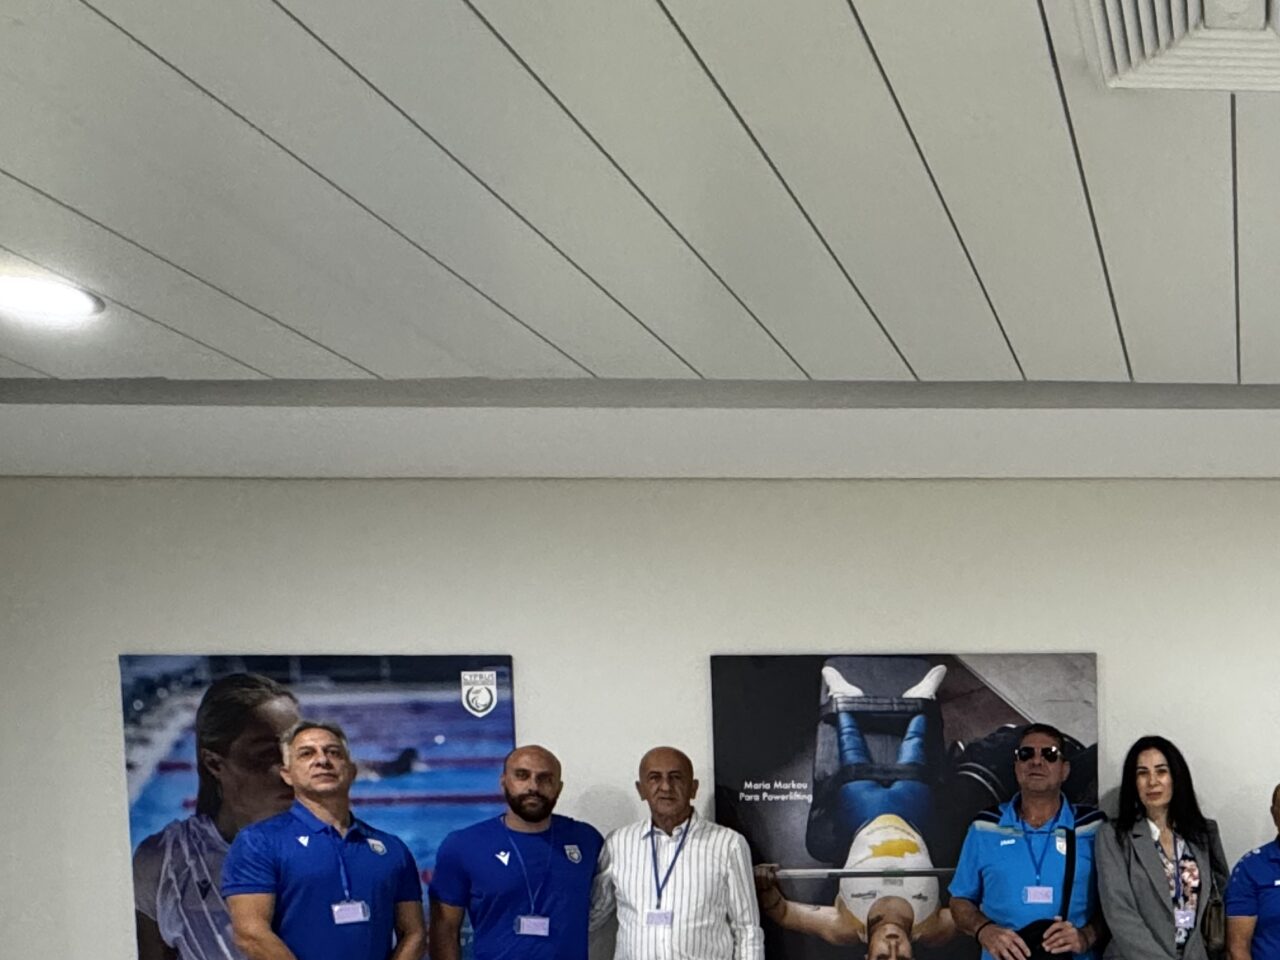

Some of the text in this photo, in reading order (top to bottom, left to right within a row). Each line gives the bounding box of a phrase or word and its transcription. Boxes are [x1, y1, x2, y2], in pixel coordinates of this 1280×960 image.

[744, 780, 808, 789] Maria Markou
[739, 791, 813, 803] Para Powerlifting
